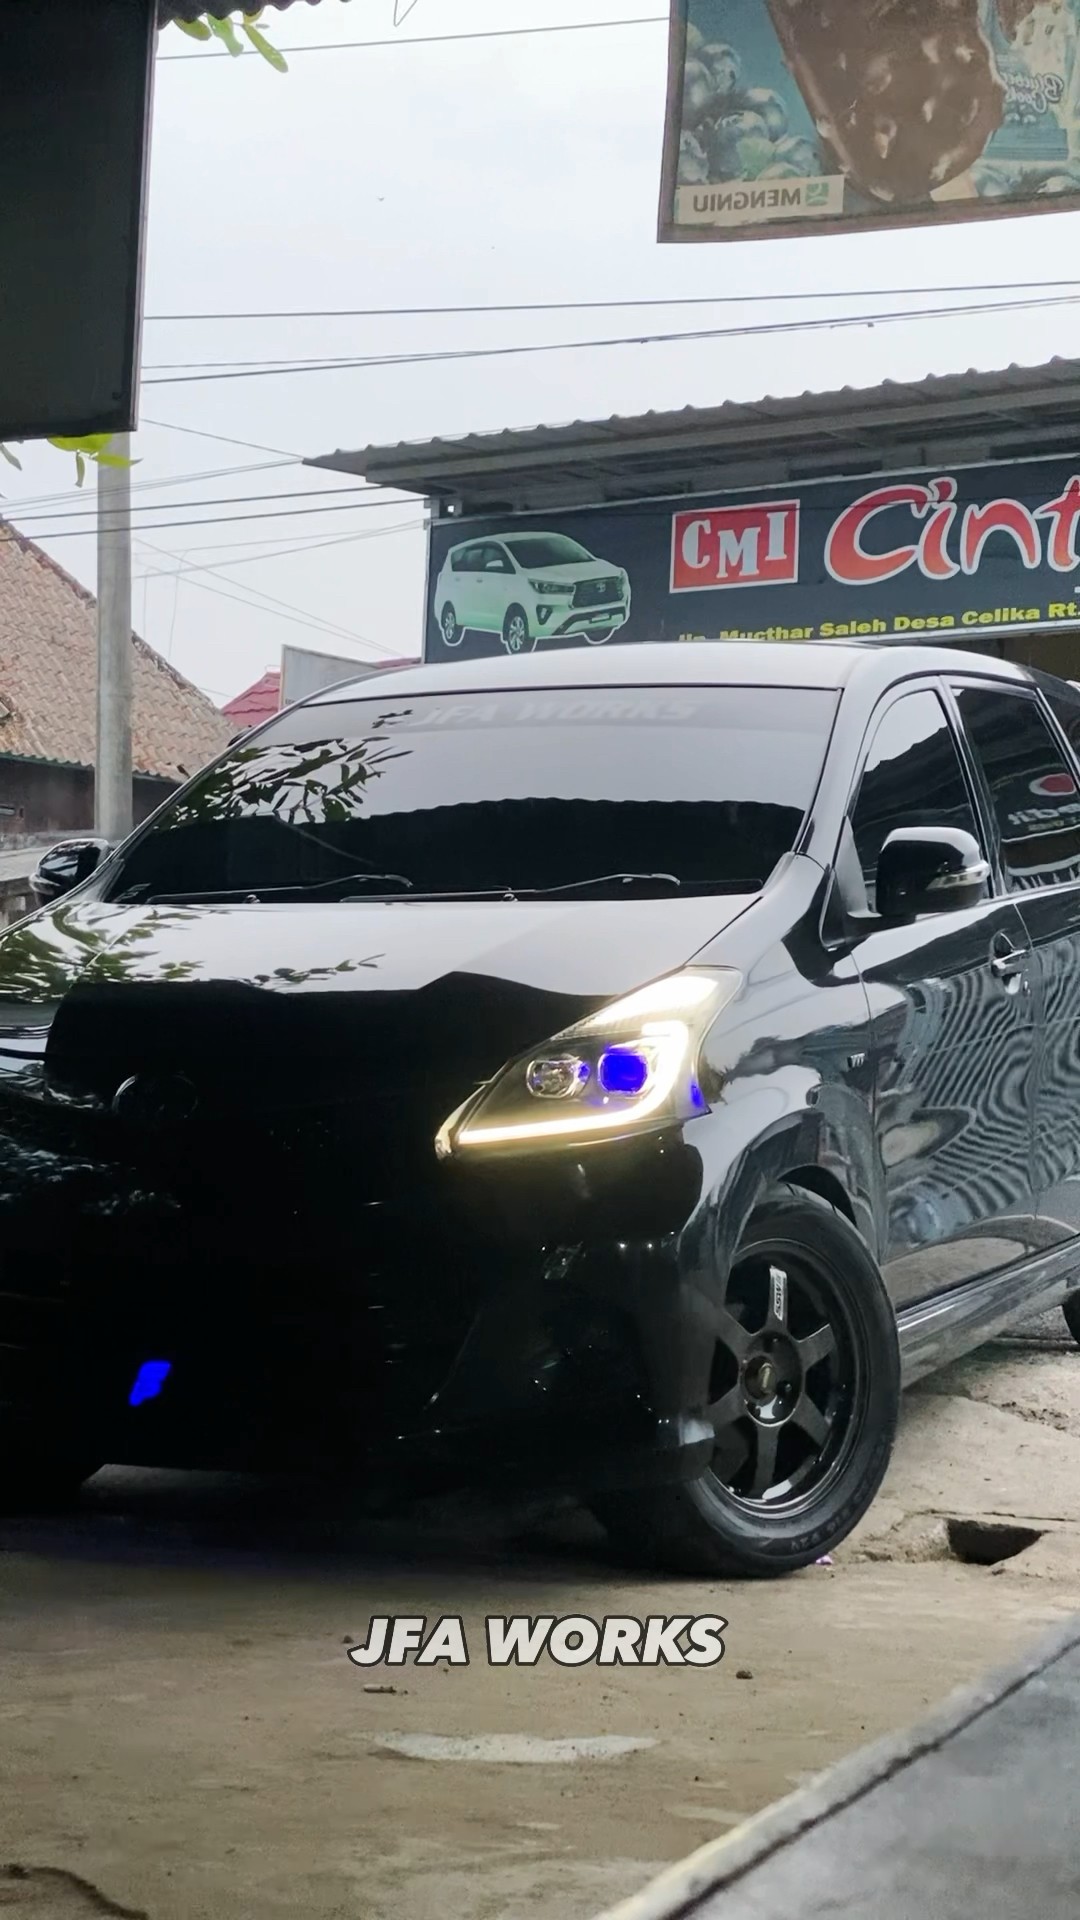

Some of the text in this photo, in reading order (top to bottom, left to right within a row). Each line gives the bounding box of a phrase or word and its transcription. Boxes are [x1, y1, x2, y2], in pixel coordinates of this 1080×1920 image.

[681, 511, 788, 578] CMI
[820, 619, 886, 637] Saleh
[894, 615, 954, 631] Desa
[407, 701, 697, 727] JFA WORKS
